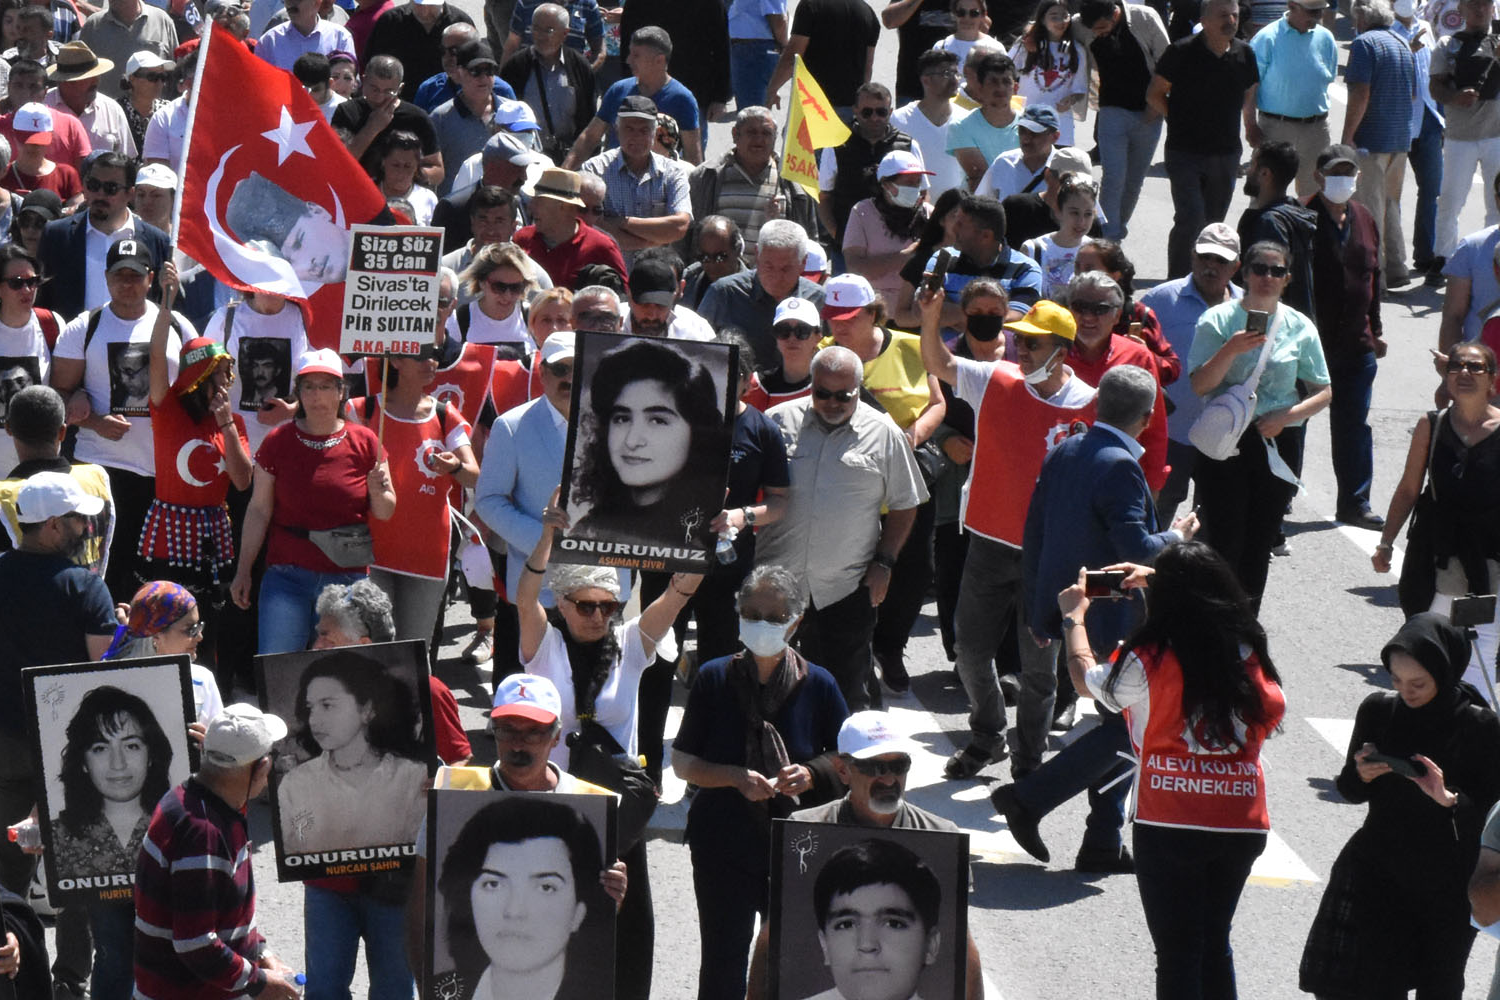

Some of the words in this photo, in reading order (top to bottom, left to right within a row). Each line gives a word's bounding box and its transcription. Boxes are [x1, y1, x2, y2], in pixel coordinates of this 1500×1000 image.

[785, 152, 819, 180] SAK
[360, 236, 398, 252] Size
[401, 236, 434, 253] Söz
[364, 253, 388, 270] 35
[392, 254, 427, 270] Can
[357, 275, 430, 293] Sivas'ta
[351, 294, 432, 312] Dirilecek
[344, 312, 373, 332] PİR
[377, 316, 435, 333] SULTAN
[352, 339, 421, 354] AKA-DER
[561, 538, 708, 561] ONURUMUZ
[598, 555, 639, 568] ASUMAN
[642, 559, 666, 570] SİVRİ
[1146, 753, 1197, 773] ALEVİ
[1150, 773, 1258, 797] DERNEKLERİ
[284, 844, 416, 867] ONURUMU
[326, 863, 368, 876] NURCAN
[57, 873, 137, 891] ONUR
[99, 886, 133, 900] HURİYE
